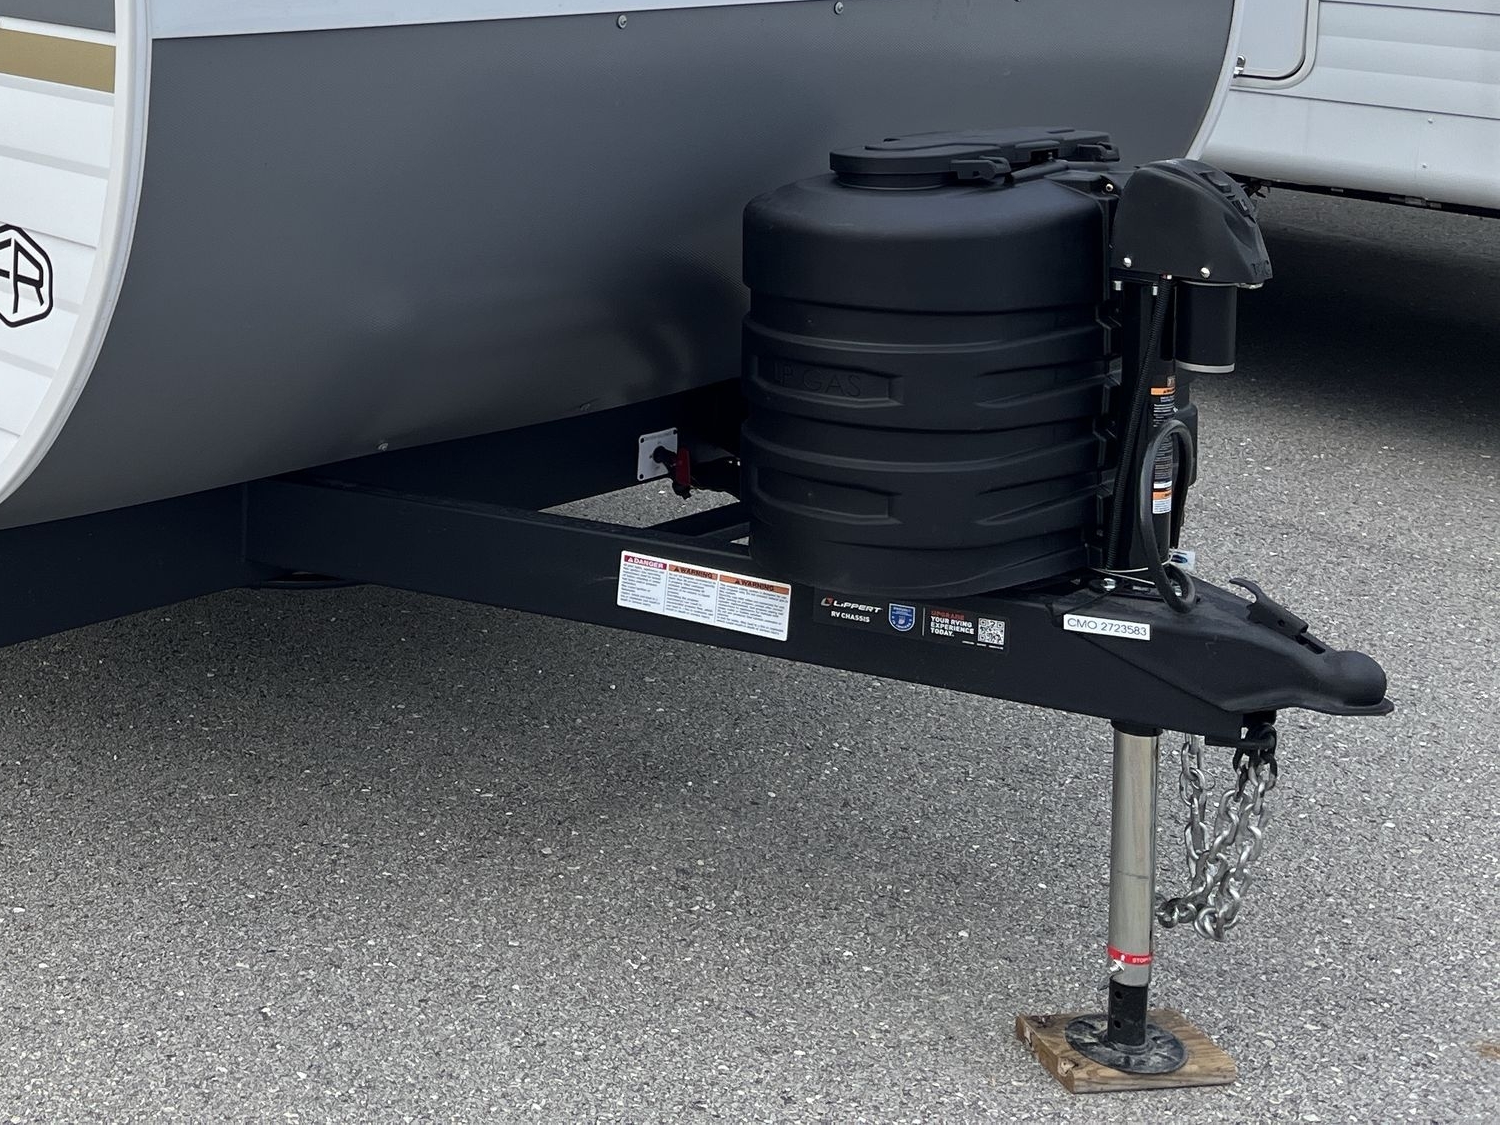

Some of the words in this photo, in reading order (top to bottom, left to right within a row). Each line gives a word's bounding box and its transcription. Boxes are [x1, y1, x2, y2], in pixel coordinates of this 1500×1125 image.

[634, 558, 664, 569] DANGER
[680, 569, 712, 580] WARNING
[740, 580, 774, 592] WARNING
[841, 613, 870, 623] CHASSIS
[931, 616, 950, 625] YOUR
[951, 619, 972, 628] RVING
[931, 622, 974, 635] EXPERIENCE
[931, 627, 955, 637] TODAY.
[1067, 617, 1098, 630] CMO
[1101, 621, 1147, 636] 2723583
